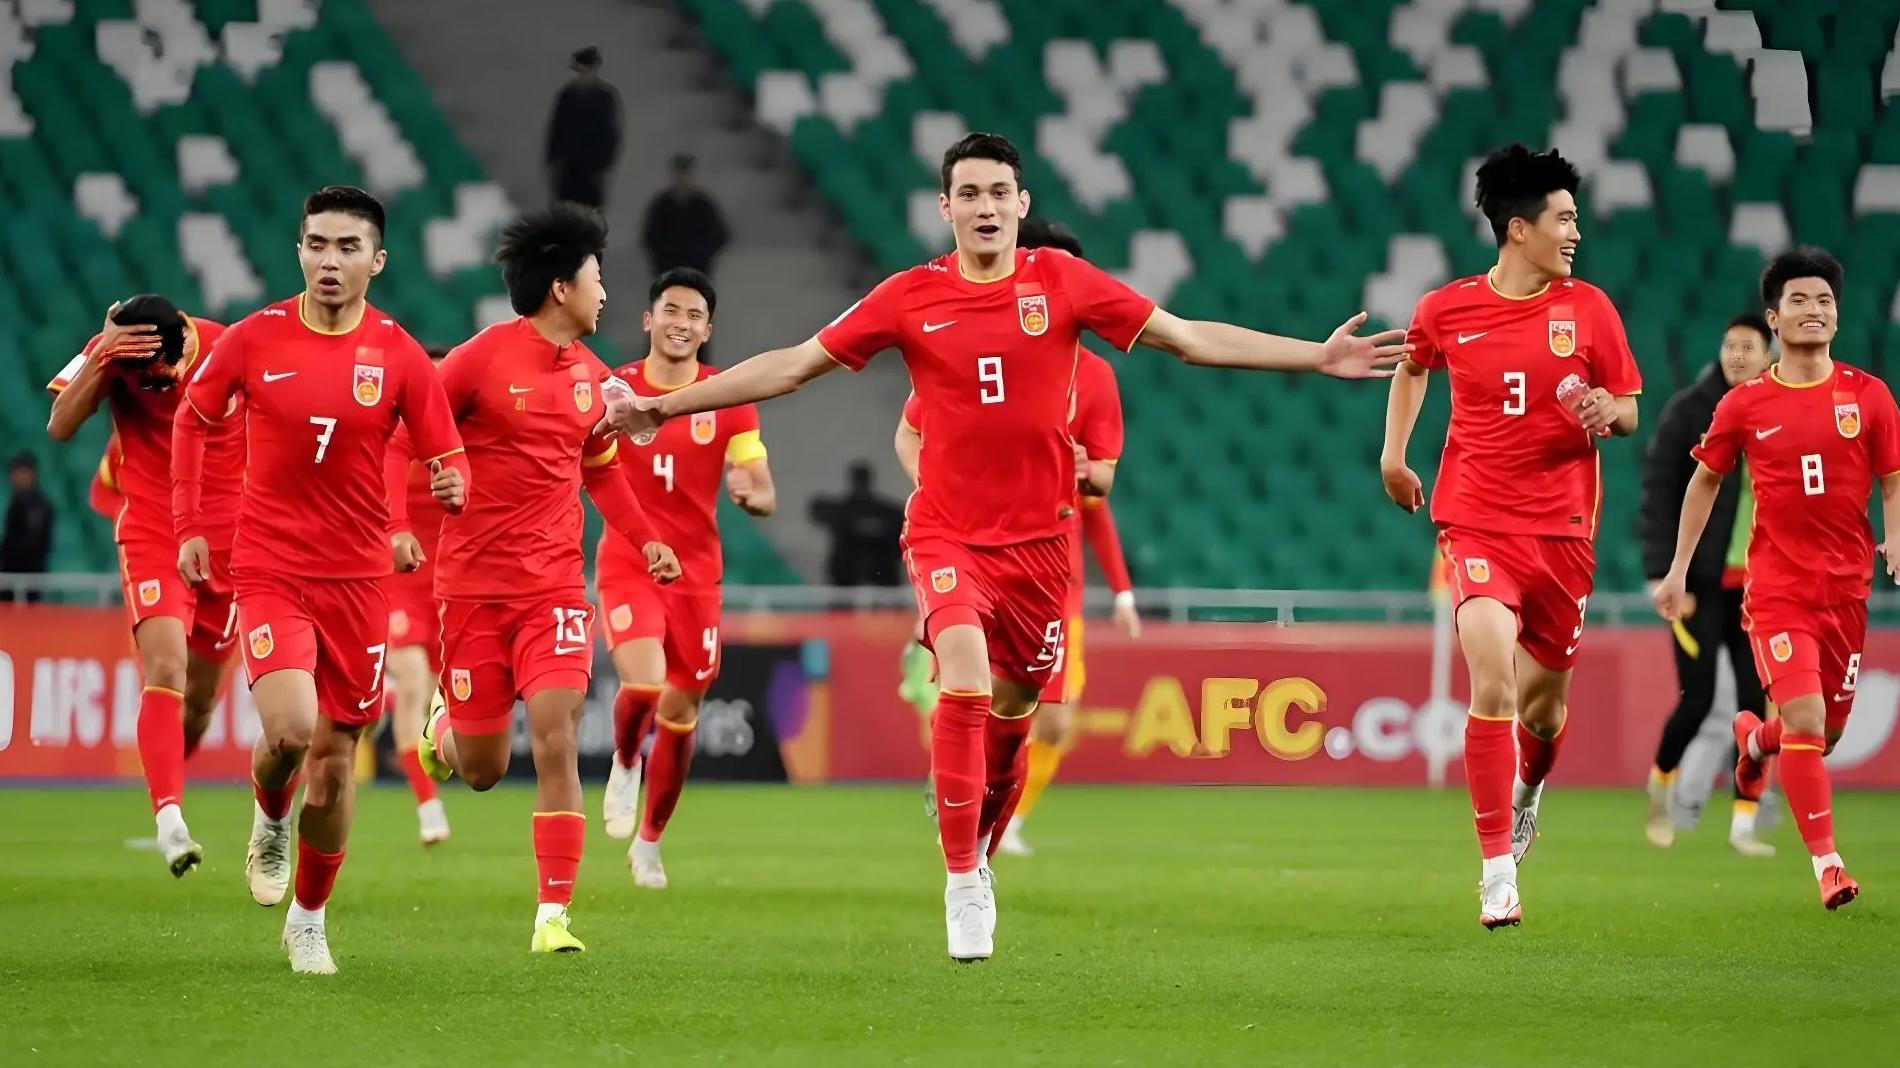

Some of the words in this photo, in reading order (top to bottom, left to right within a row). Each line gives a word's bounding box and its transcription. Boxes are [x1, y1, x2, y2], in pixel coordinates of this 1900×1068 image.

[978, 356, 1005, 405] 9
[1503, 372, 1525, 416] 3
[310, 416, 337, 464] 7
[653, 453, 674, 493] 4
[1801, 454, 1825, 496] 8
[553, 607, 588, 644] 13
[1573, 594, 1588, 640] 3
[703, 626, 719, 666] 4
[1036, 619, 1062, 661] 9
[366, 642, 386, 692] 7
[1842, 653, 1862, 691] 8
